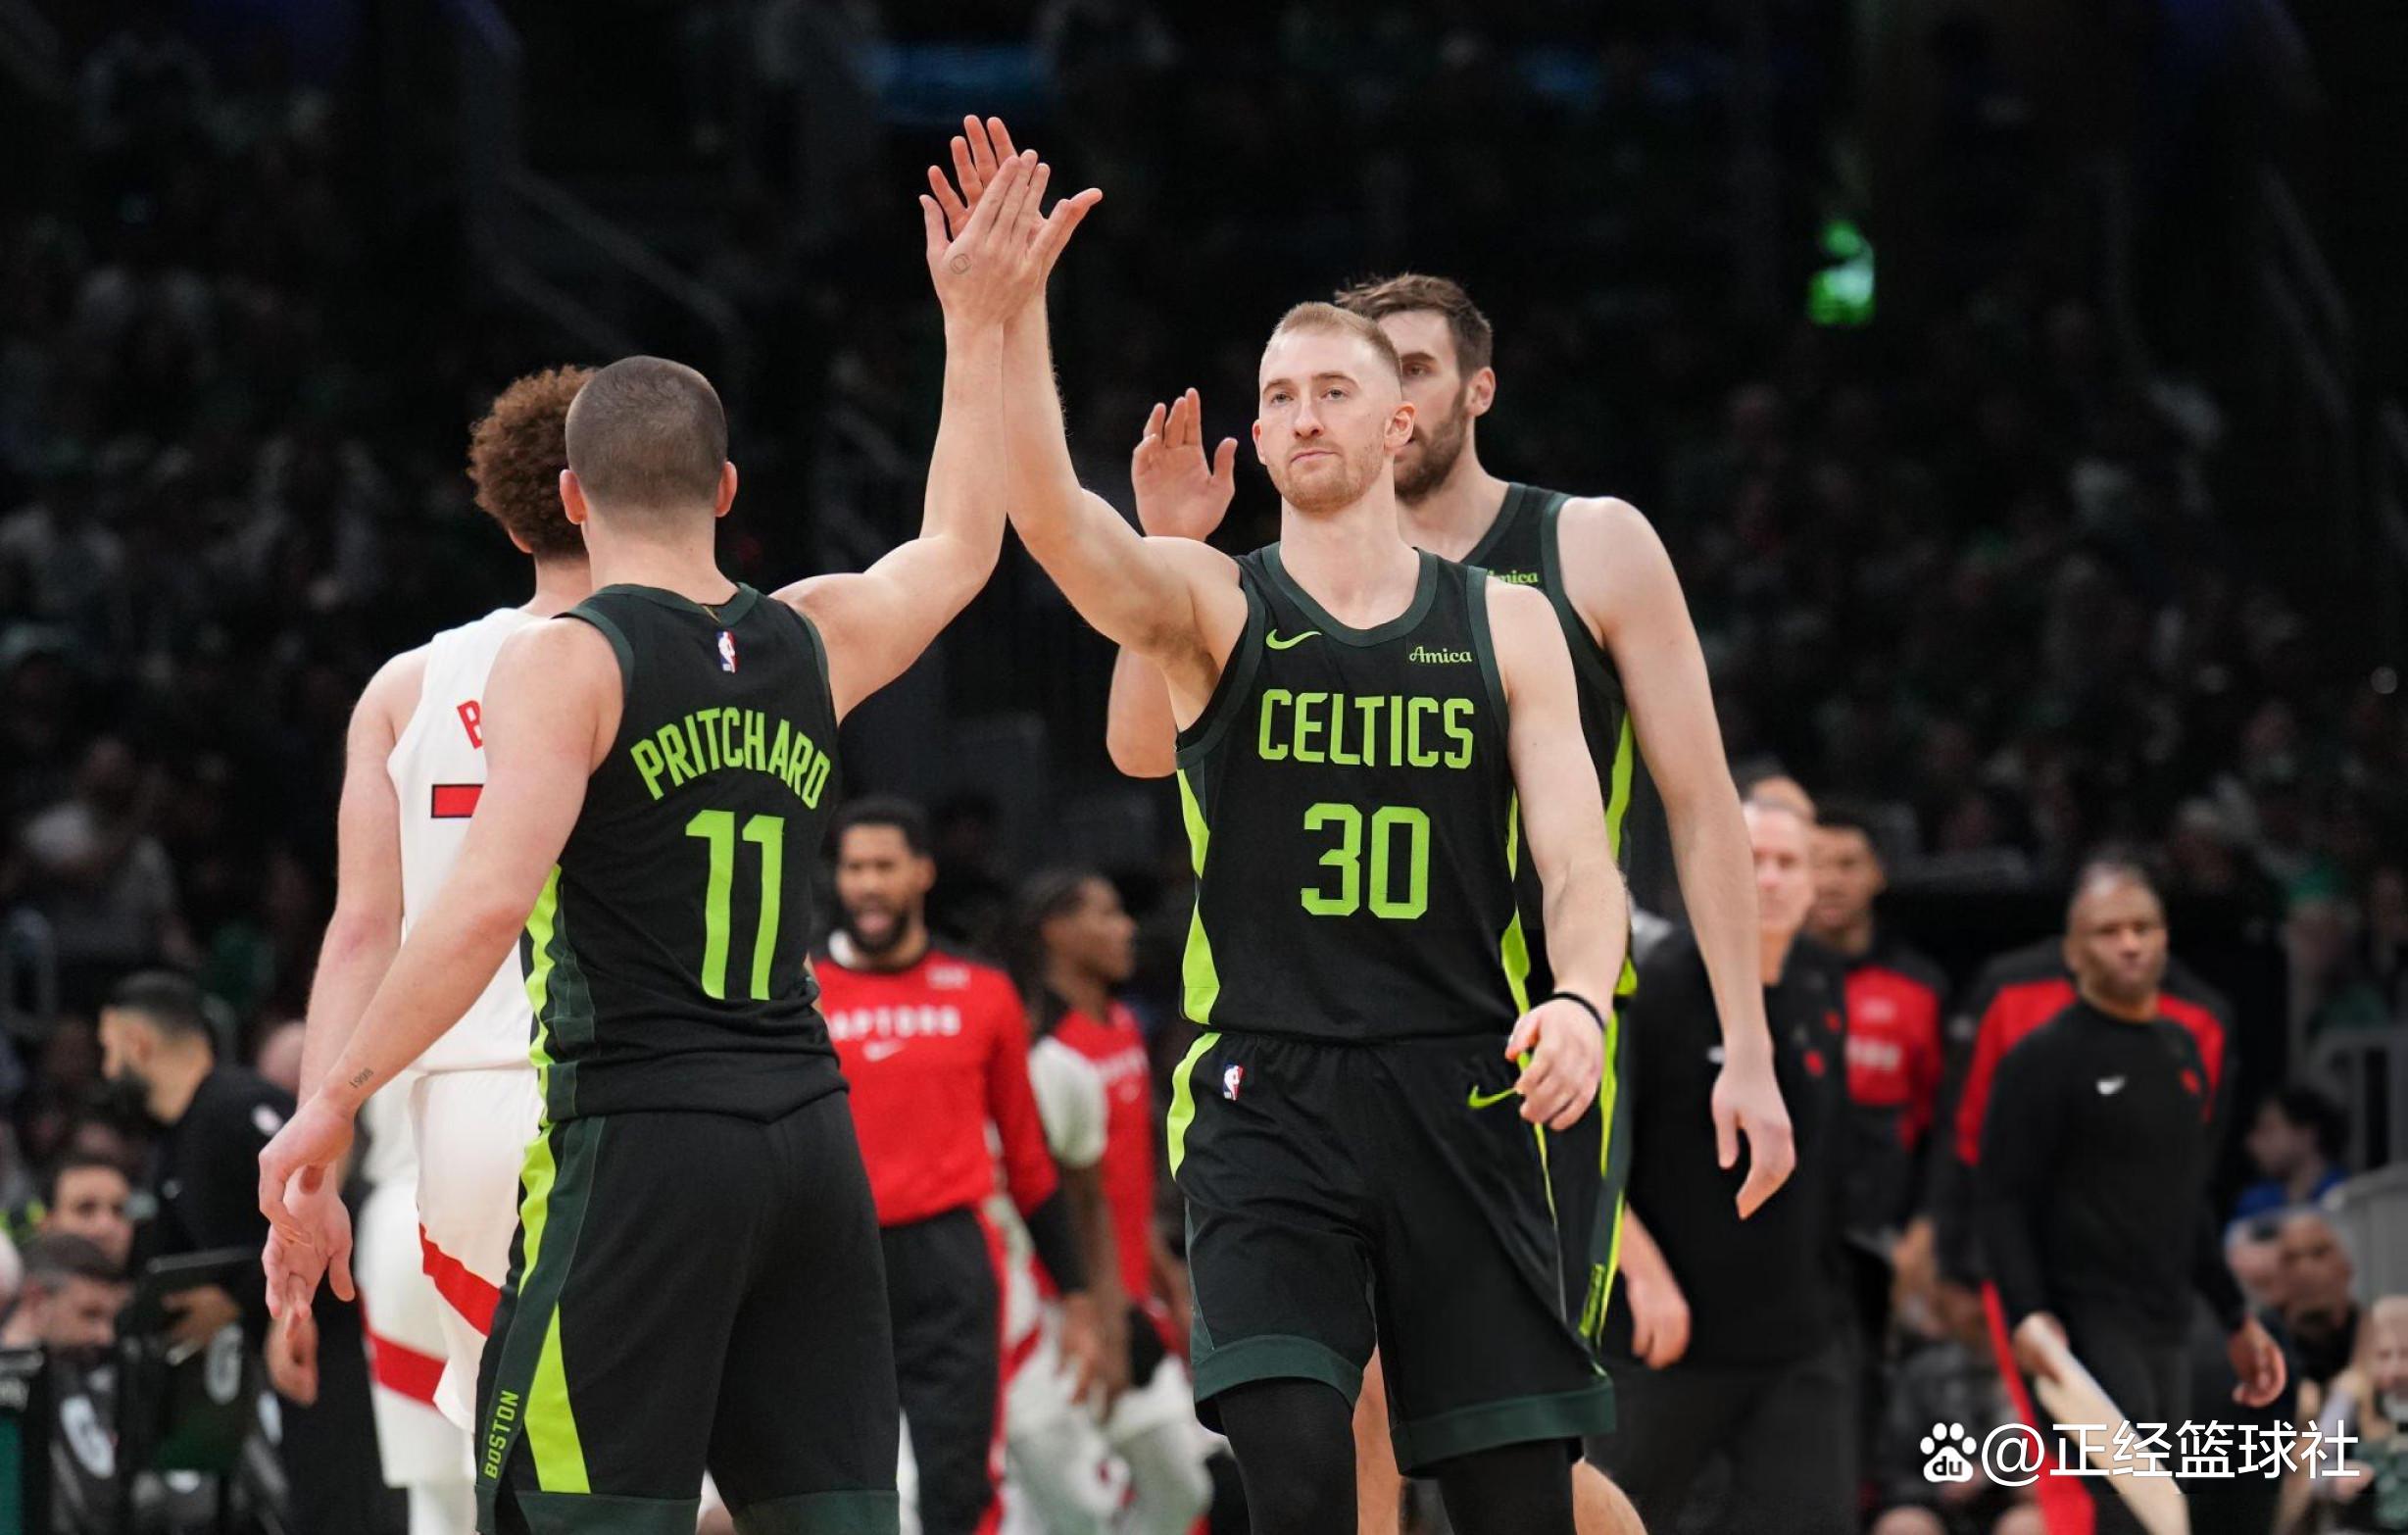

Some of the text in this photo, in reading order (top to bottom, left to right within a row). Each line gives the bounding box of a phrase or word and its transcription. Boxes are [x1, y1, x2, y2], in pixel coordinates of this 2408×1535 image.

[1488, 569, 1539, 584] ica
[1408, 645, 1473, 664] Amica
[630, 706, 831, 810] PRITCHARD
[1258, 689, 1474, 769] CELTICS
[686, 809, 785, 1001] 11
[1301, 802, 1431, 919] 30
[483, 1390, 519, 1479] BOSTON
